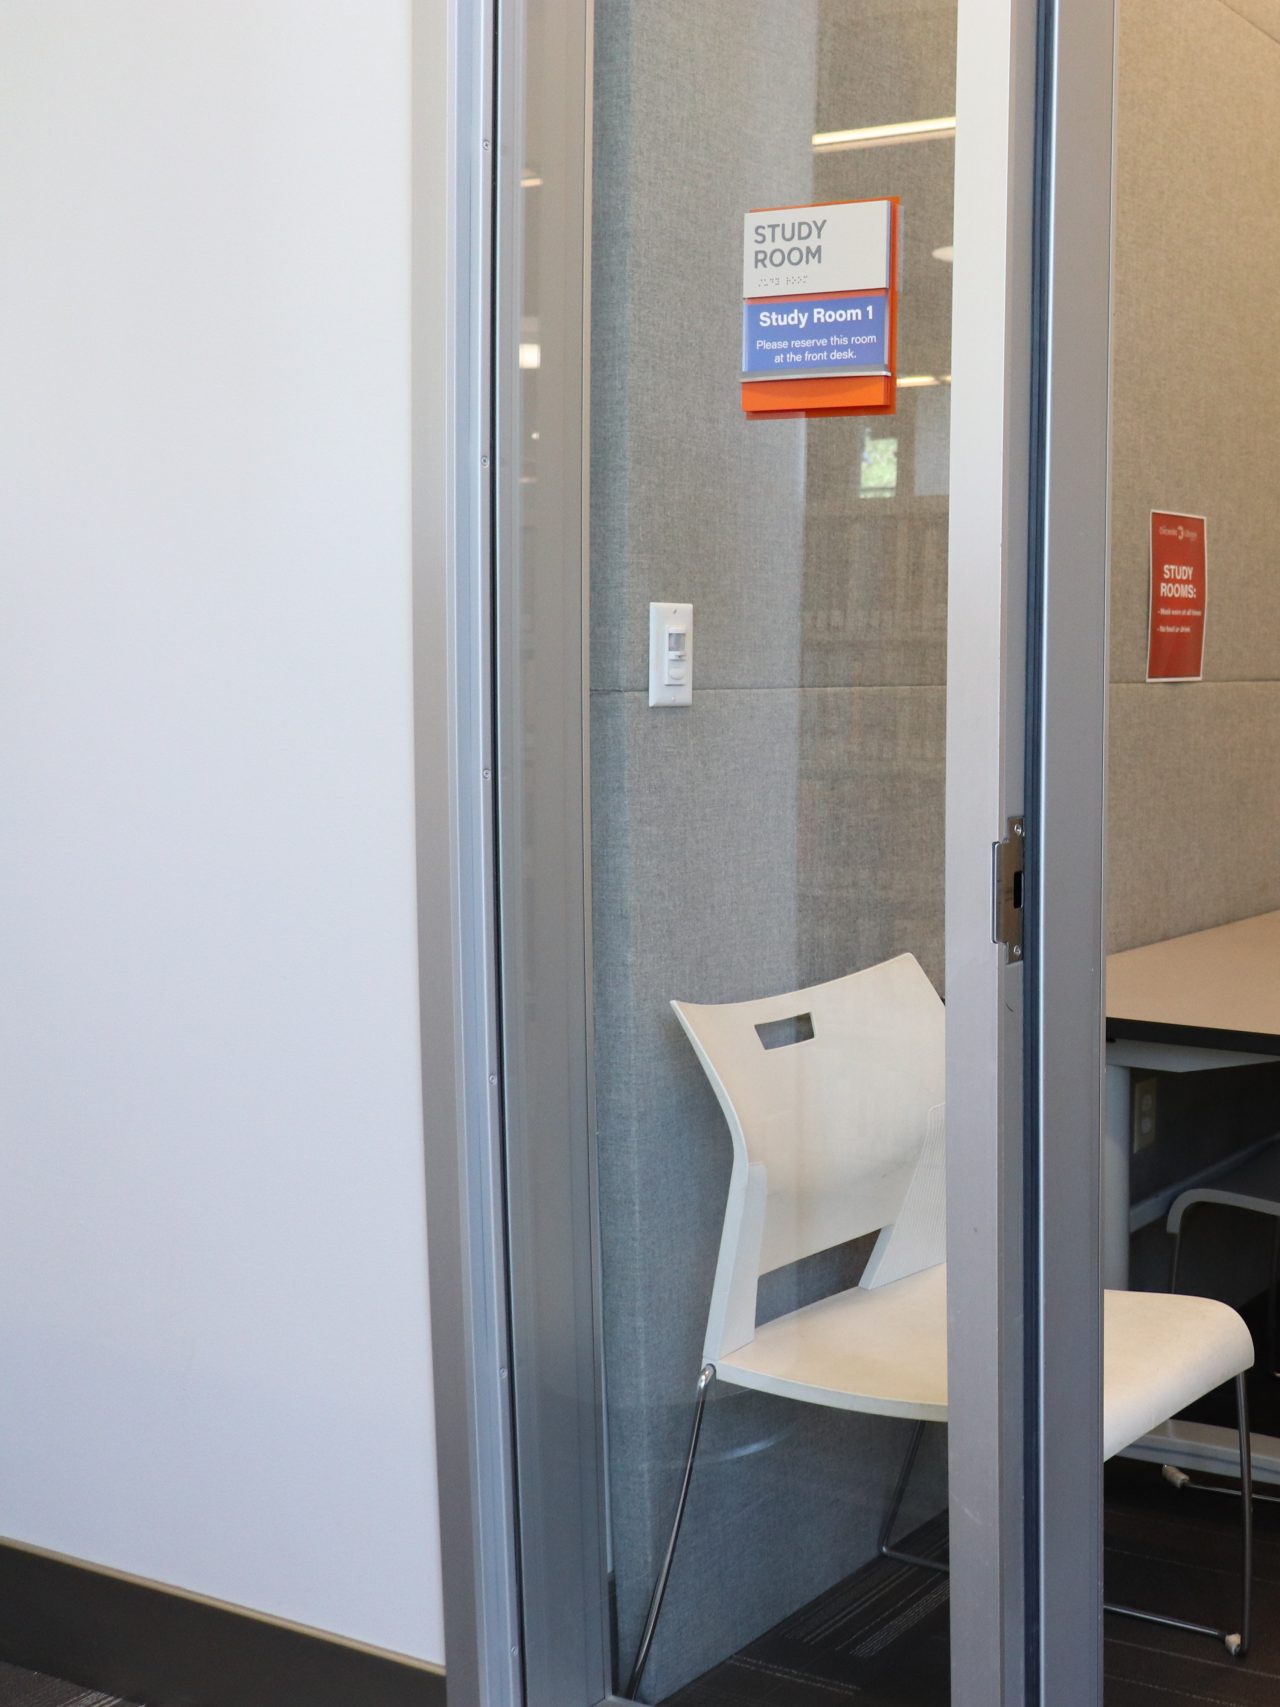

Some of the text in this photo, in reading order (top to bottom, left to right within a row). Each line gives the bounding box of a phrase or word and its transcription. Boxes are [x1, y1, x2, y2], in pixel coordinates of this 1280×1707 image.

[754, 219, 827, 244] STUDY
[754, 245, 822, 269] ROOM
[759, 305, 873, 328] Study Room 1
[756, 334, 877, 350] Please reserve this room
[774, 349, 857, 363] at the front desk.
[1163, 564, 1194, 580] STUDY
[1160, 582, 1197, 599] ROOMS:
